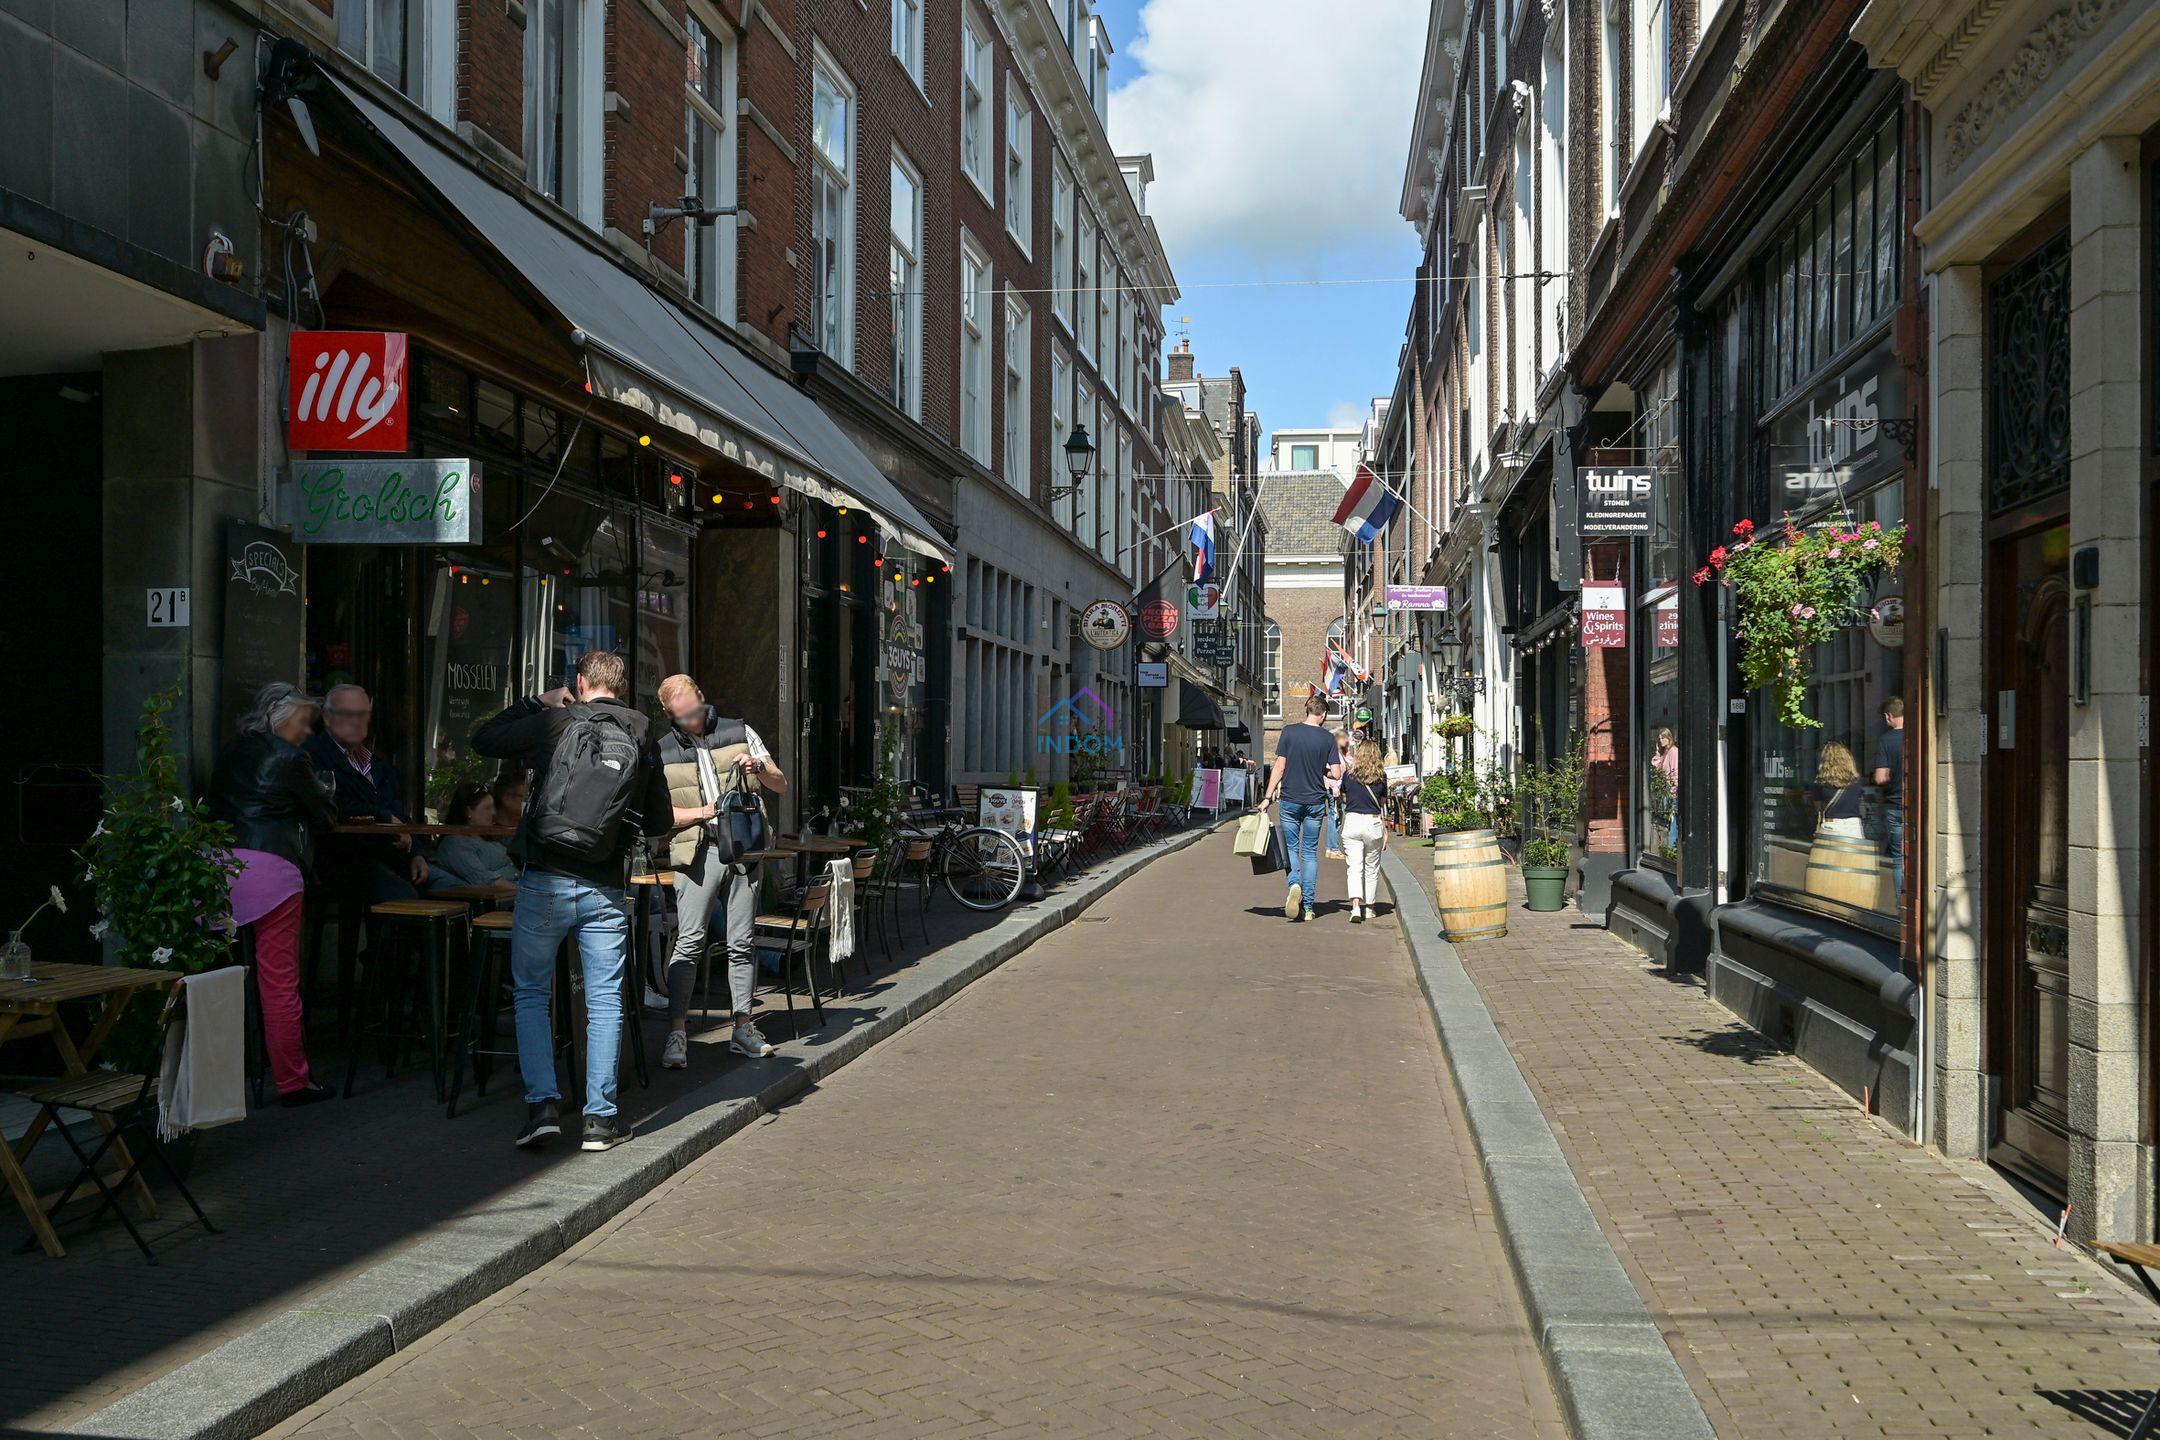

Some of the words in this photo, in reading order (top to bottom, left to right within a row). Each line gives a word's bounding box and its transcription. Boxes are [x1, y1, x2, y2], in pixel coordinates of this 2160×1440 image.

[298, 349, 399, 440] illy
[1807, 375, 1879, 472] twins
[1586, 470, 1652, 491] twins
[301, 468, 461, 534] Grolsch
[1083, 605, 1100, 627] BIRRA
[1101, 603, 1127, 627] MORETTI
[1586, 612, 1615, 621] Wines
[1583, 621, 1595, 635] &
[1594, 621, 1624, 634] Spirits
[888, 645, 911, 670] 3GUYS
[447, 662, 497, 692] MOSSELEN
